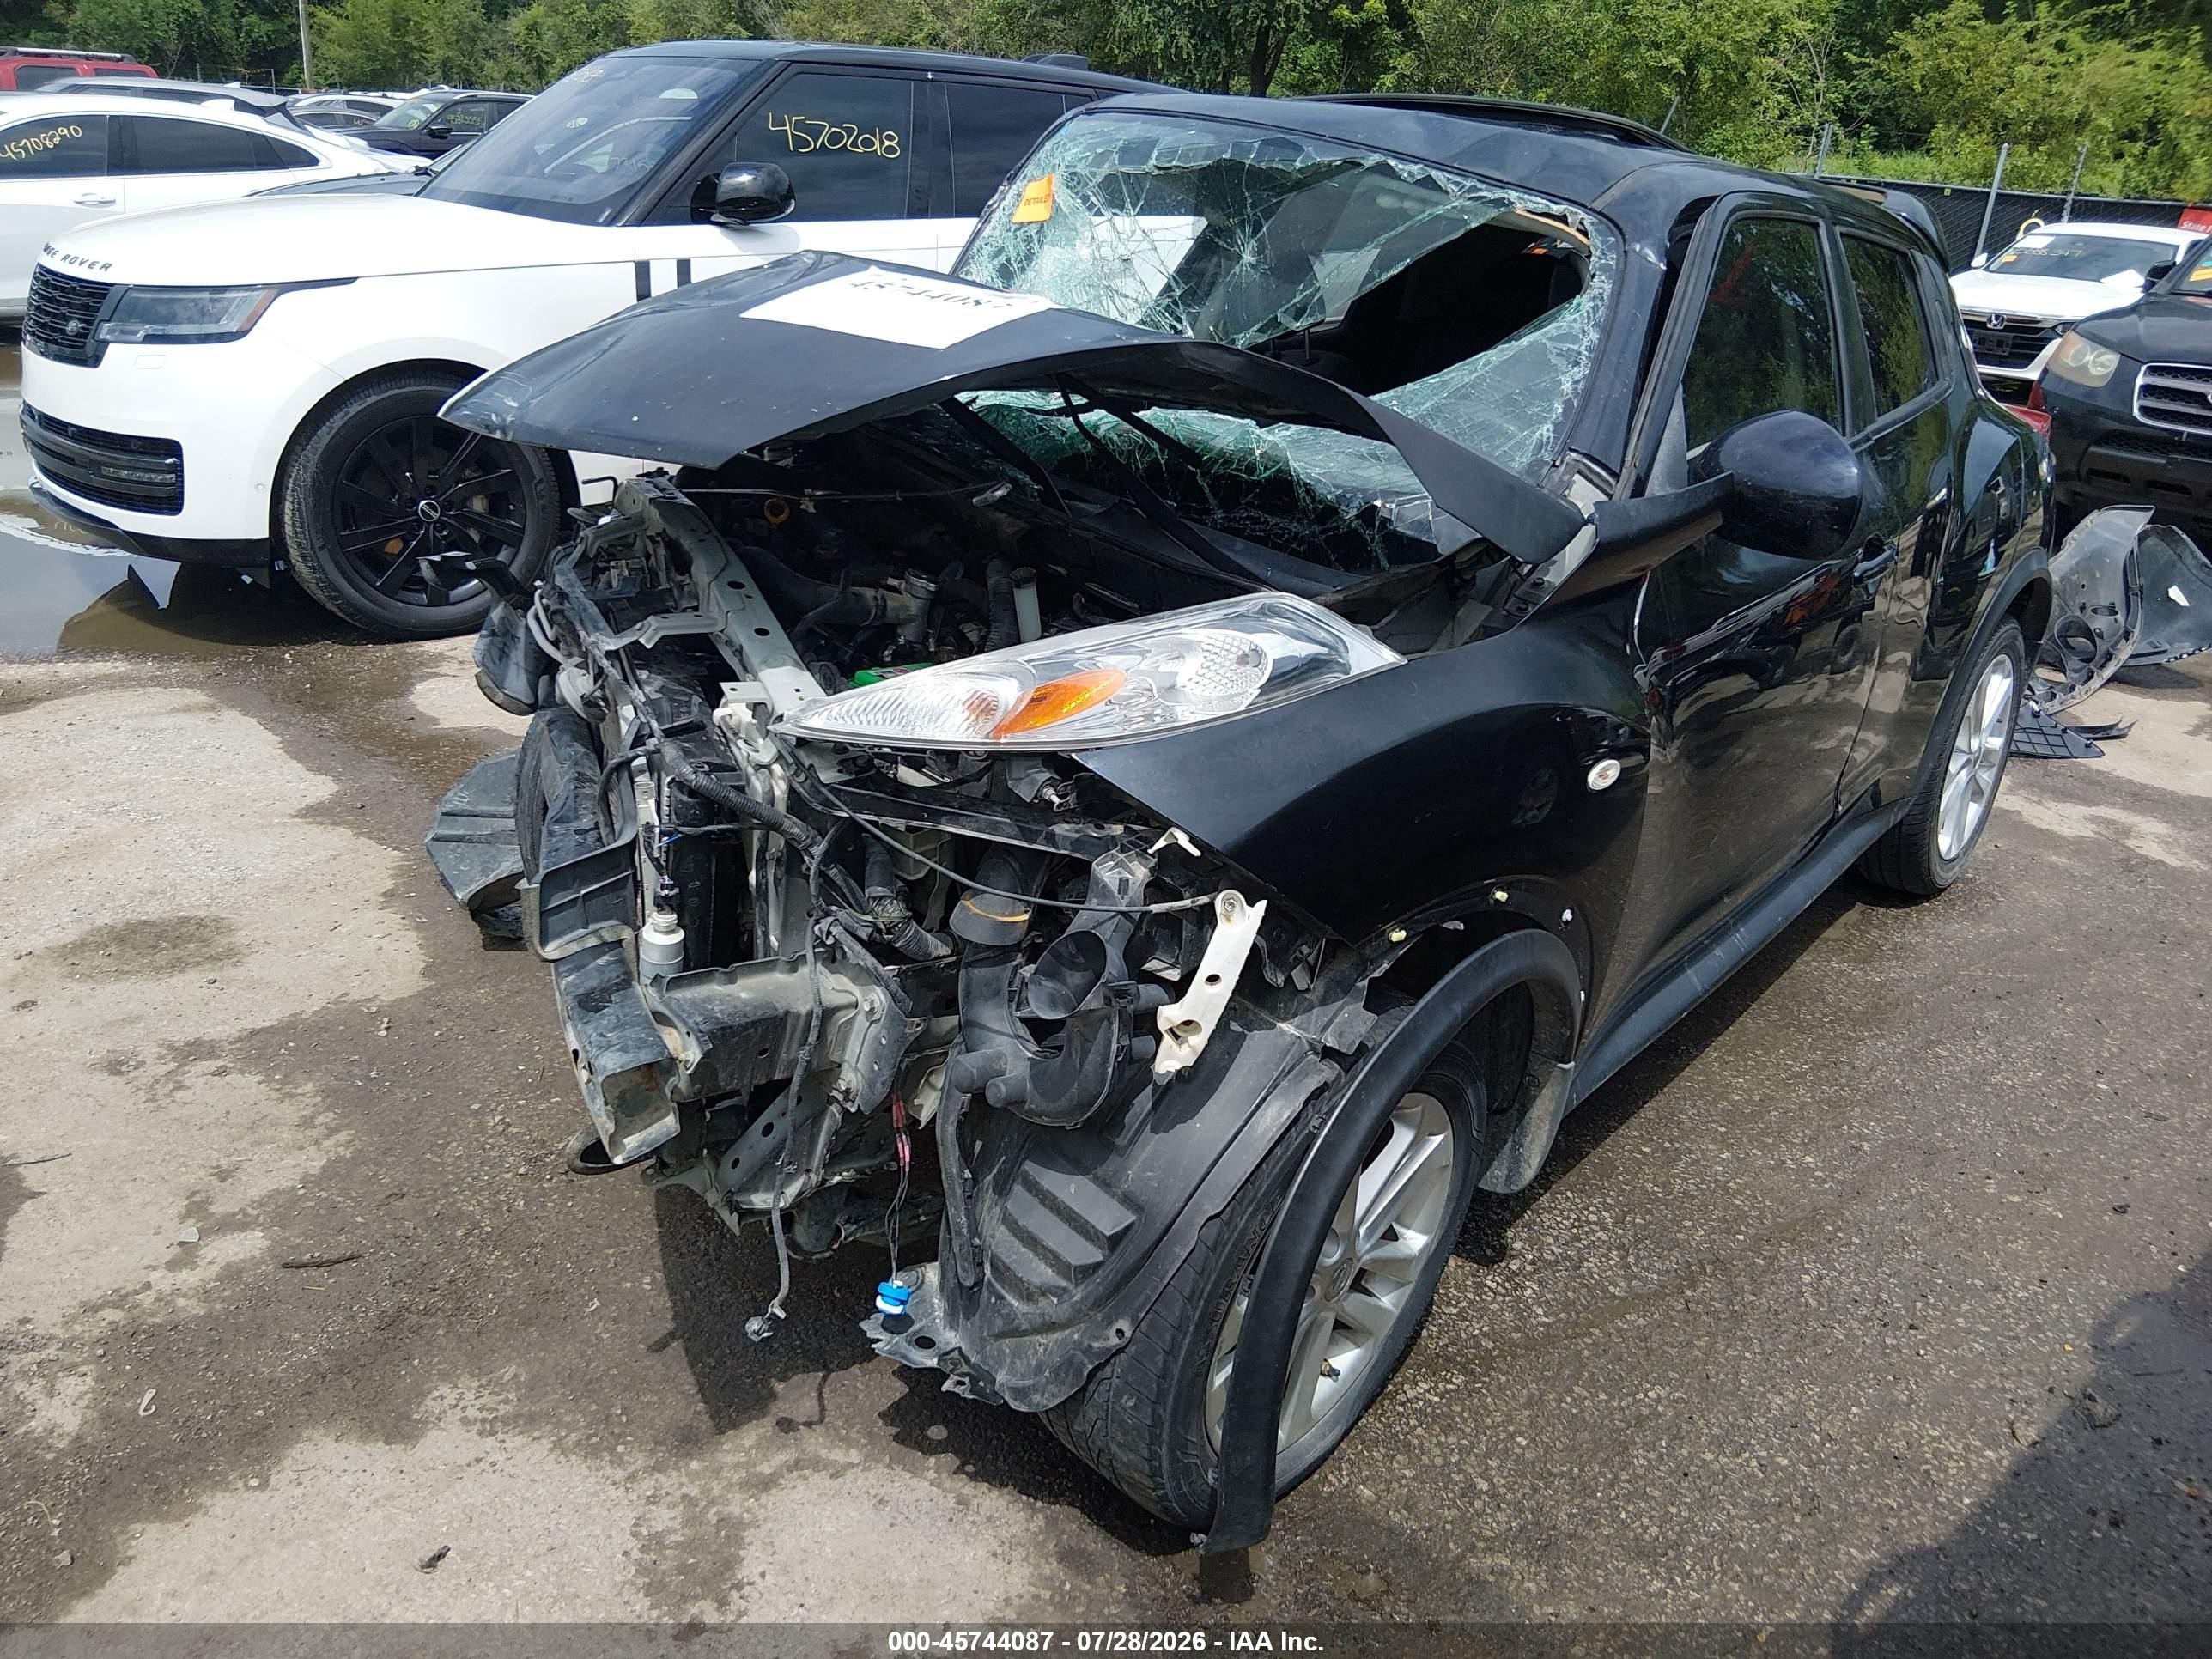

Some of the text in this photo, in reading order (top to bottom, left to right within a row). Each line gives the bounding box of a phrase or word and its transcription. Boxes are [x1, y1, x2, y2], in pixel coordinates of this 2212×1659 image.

[0, 125, 82, 161] 45708290
[769, 112, 901, 158] 45702018
[60, 253, 112, 272] ROVER
